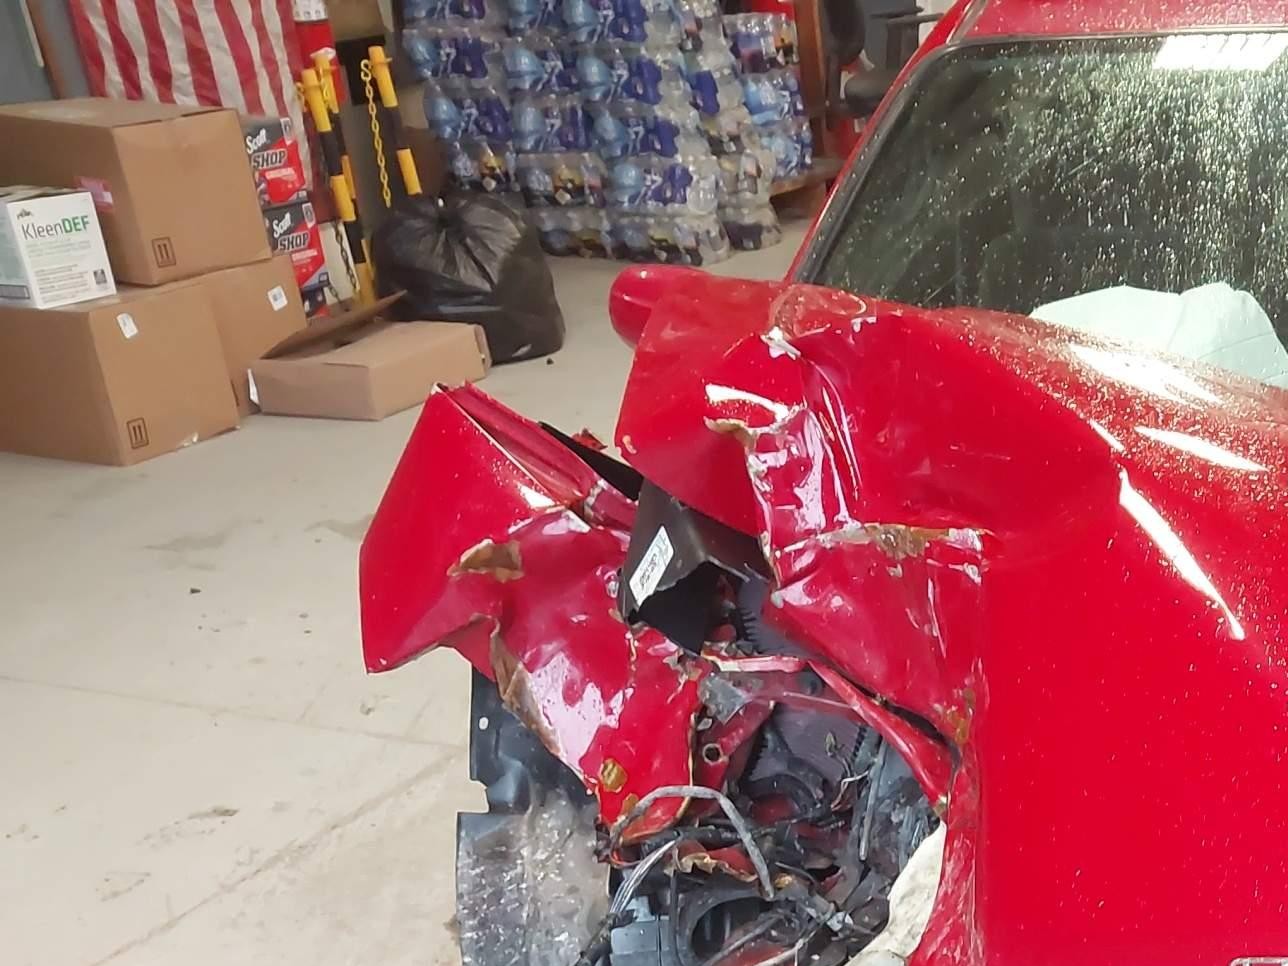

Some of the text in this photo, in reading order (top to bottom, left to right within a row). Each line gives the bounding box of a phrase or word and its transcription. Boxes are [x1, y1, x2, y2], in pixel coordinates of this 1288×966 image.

[252, 149, 287, 169] SHOP
[21, 215, 91, 241] KleenDEF
[278, 231, 309, 251] SHOP
